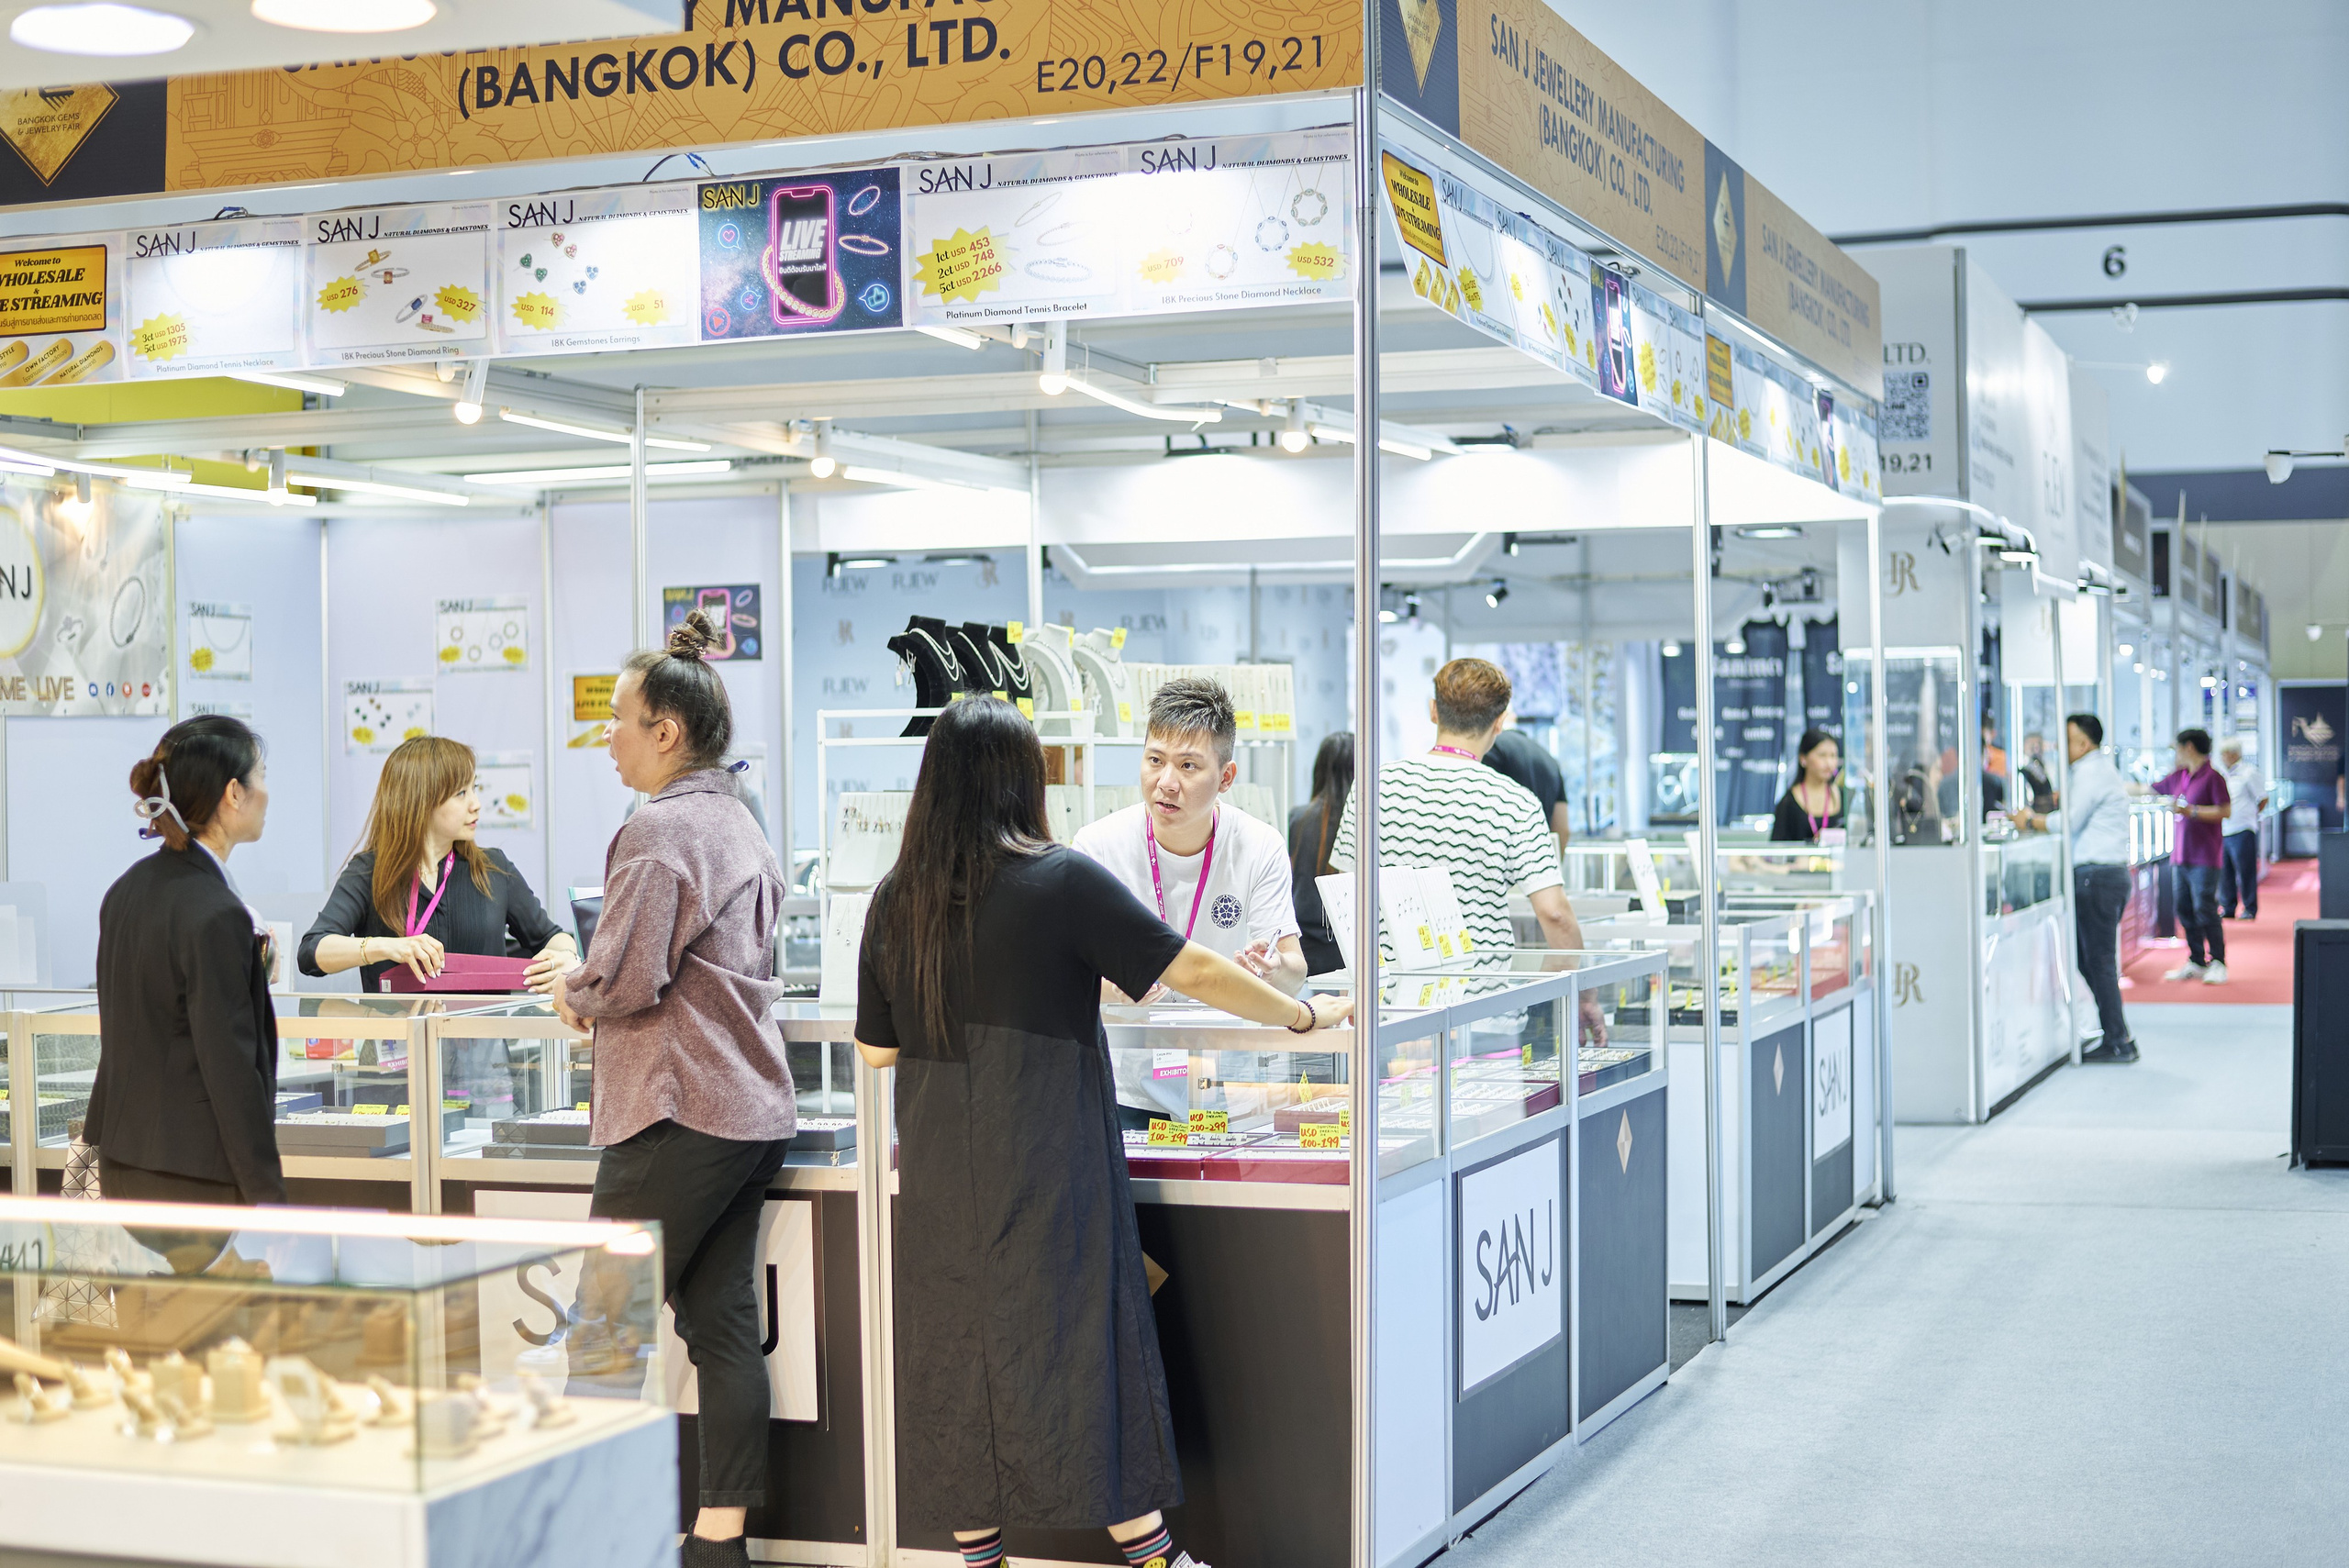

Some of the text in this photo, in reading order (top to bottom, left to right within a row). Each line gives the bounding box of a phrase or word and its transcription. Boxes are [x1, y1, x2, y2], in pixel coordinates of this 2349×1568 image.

[458, 38, 756, 120] (BANGKOK)
[779, 30, 884, 80] CO.,
[907, 17, 1010, 69] LTD.
[1037, 35, 1322, 95] E20,22/F19,21
[1491, 13, 1519, 72] SAN
[1523, 39, 1529, 79] J
[1533, 47, 1595, 127] JEWELLERY
[1598, 96, 1686, 194] MANUFACTURING
[17, 112, 81, 126] BANGKOK GEMS
[25, 124, 62, 135] JEWELRY
[62, 122, 82, 132] FAIR
[1141, 145, 1217, 175] SAN J
[1221, 161, 1255, 170] NATURAL
[1256, 157, 1296, 168] DIAMONDS
[1303, 153, 1348, 163] GEMSTONES
[1538, 103, 1606, 191] (BANGKOK)
[1633, 170, 1653, 217] LTD.
[918, 163, 992, 194] SAN J
[996, 178, 1030, 187] NATURAL
[1030, 175, 1068, 185] DIAMONDS
[1074, 172, 1119, 182] GEMSTONES
[703, 185, 759, 210] SAN J
[1391, 179, 1431, 211] WHOLESALE
[1441, 178, 1464, 212] SAN J
[507, 199, 573, 228] SAN J
[578, 214, 607, 222] NATURAL
[607, 211, 643, 220] DIAMONDS
[649, 208, 689, 217] GEMSTONES
[317, 216, 379, 244] SAN J
[384, 229, 413, 239] NATURAL
[412, 228, 446, 236] DIAMONDS
[451, 224, 489, 232] GEMSTONES
[780, 218, 828, 250] LIVE
[1406, 212, 1441, 241] STREAMING
[1497, 210, 1511, 238] SAN
[136, 231, 196, 258] SAN J
[261, 239, 299, 248] GEMSTONES
[936, 237, 990, 263] 1ct USD 453
[15, 257, 61, 267] Welcome to
[779, 248, 822, 261] STREAMING
[937, 249, 995, 280] 2ct USD 748
[1147, 256, 1185, 272] USD 709
[1297, 255, 1334, 268] USD 532
[2102, 245, 2128, 278] 6
[939, 262, 1002, 295] 5ct USD 2266
[10, 291, 103, 312] STREAMING
[326, 285, 358, 302] USD 276
[1162, 285, 1322, 305] 18K Precious Stone Diamond Necklace
[443, 295, 476, 313] USD 327
[520, 303, 554, 317] USD 114
[631, 299, 664, 312] USD 51
[946, 302, 1087, 319] Platinum Diamond Tennis Bracelet
[142, 323, 186, 343] 3ct USD 1305
[551, 335, 640, 348] 18K Gemstones Earrings
[144, 343, 156, 353] 5ct
[168, 334, 188, 347] 1975
[341, 346, 460, 361] 18K Precious Stone Diamond Ring
[1882, 342, 1932, 365] LTD.
[25, 362, 38, 373] OWN
[38, 344, 61, 364] FACTORY
[59, 345, 104, 379] NATURAL DIAMONDS
[156, 358, 274, 373] Platinum Diamond Tennis Necklace
[20, 564, 32, 600] J
[190, 602, 210, 617] SAN
[440, 598, 473, 614] SAN J
[36, 676, 75, 701] LIVE
[348, 681, 380, 695] SAN J
[1160, 1067, 1188, 1077] EXHIBITO
[1819, 1051, 1842, 1118] SAN
[1152, 1121, 1166, 1130] USD
[1190, 1113, 1204, 1122] USD
[1190, 1121, 1226, 1133] 200-299
[1300, 1128, 1317, 1137] USD
[1301, 1137, 1339, 1148] 100-199
[1475, 1198, 1553, 1321] SAN J
[761, 1262, 779, 1357] J
